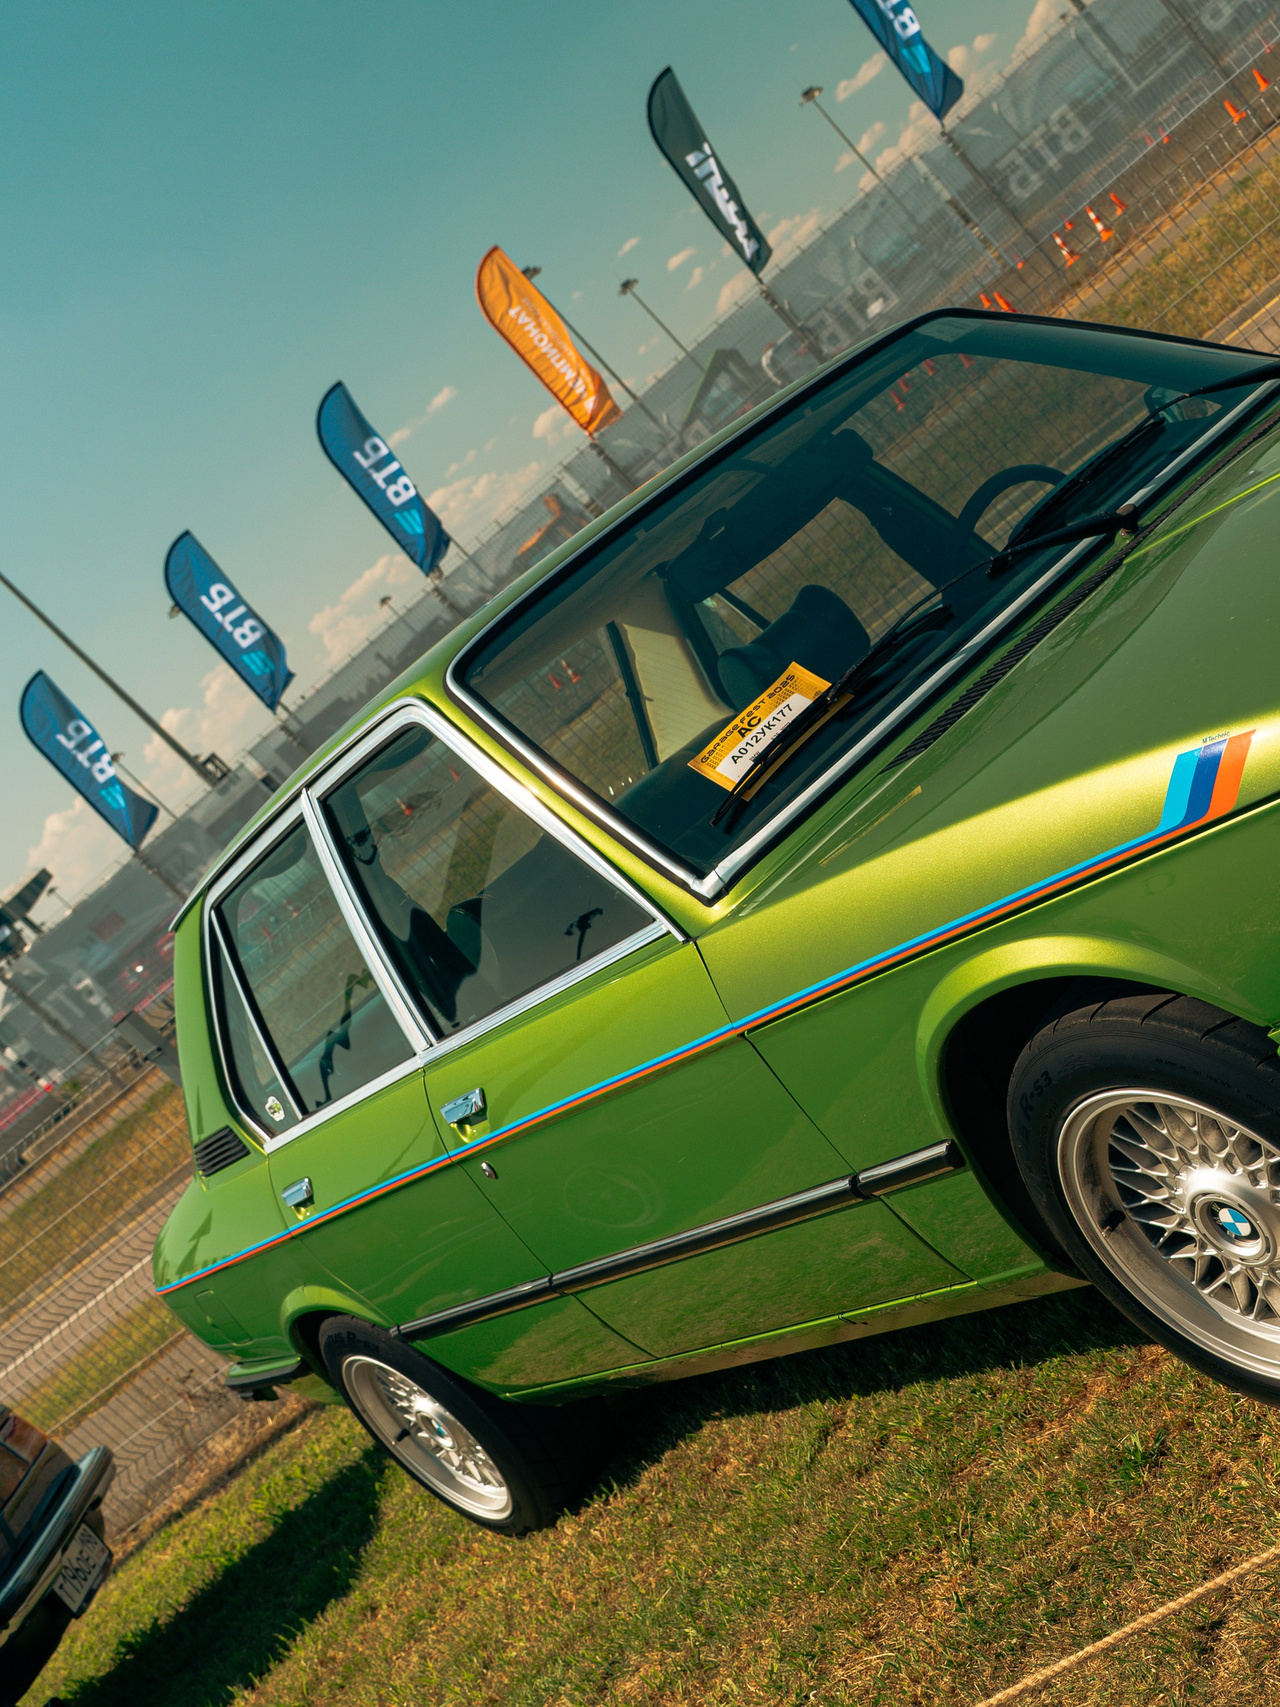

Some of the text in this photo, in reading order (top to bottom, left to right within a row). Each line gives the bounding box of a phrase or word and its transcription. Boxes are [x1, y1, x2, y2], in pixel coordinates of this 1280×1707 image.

[508, 306, 588, 399] ЧЕМПИОНАТ
[352, 436, 417, 507] ВТБ
[200, 583, 267, 649] ВТБ
[766, 673, 795, 700] 2025
[56, 719, 116, 784] ВТБ
[731, 703, 793, 765] А012УК177
